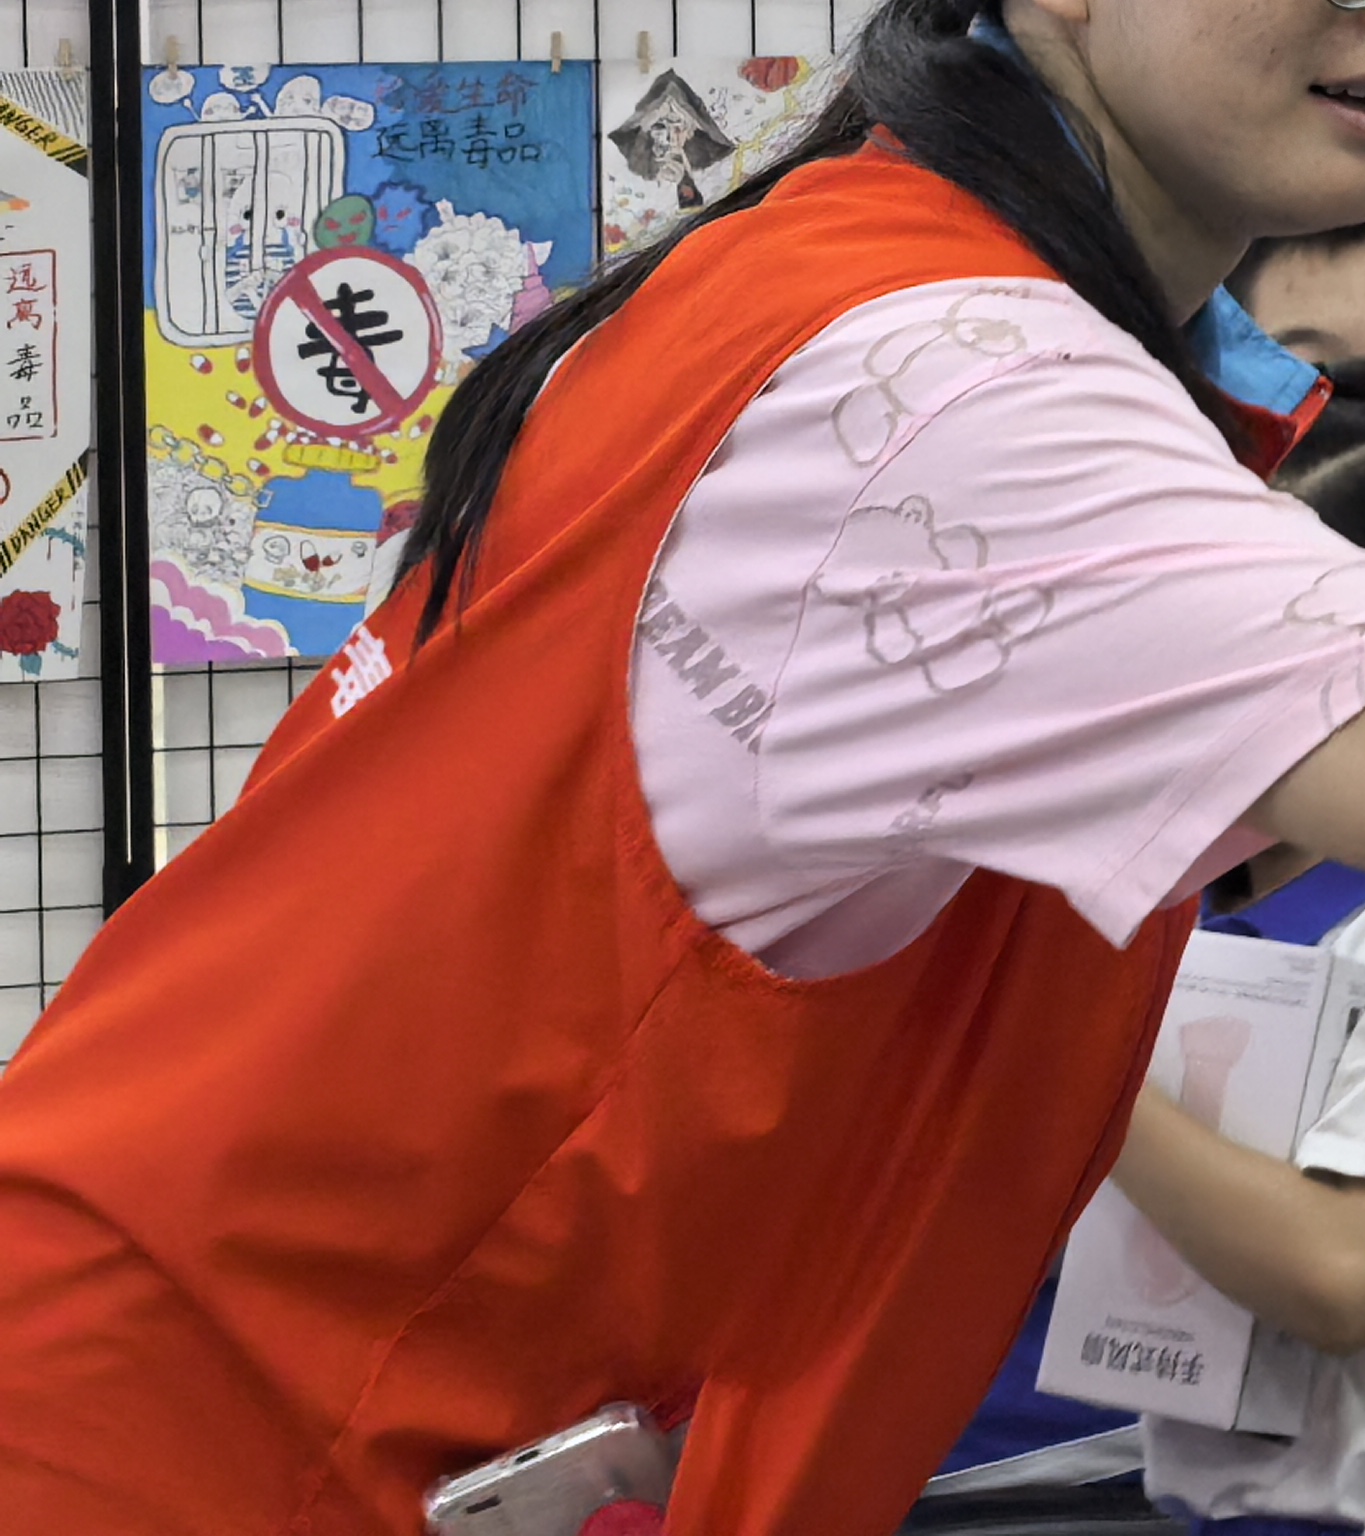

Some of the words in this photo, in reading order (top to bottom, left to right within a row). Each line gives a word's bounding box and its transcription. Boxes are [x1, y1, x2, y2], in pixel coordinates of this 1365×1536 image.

[371, 113, 543, 169] 远离毒品
[298, 282, 403, 415] 毒
[11, 486, 71, 554] DANGER
